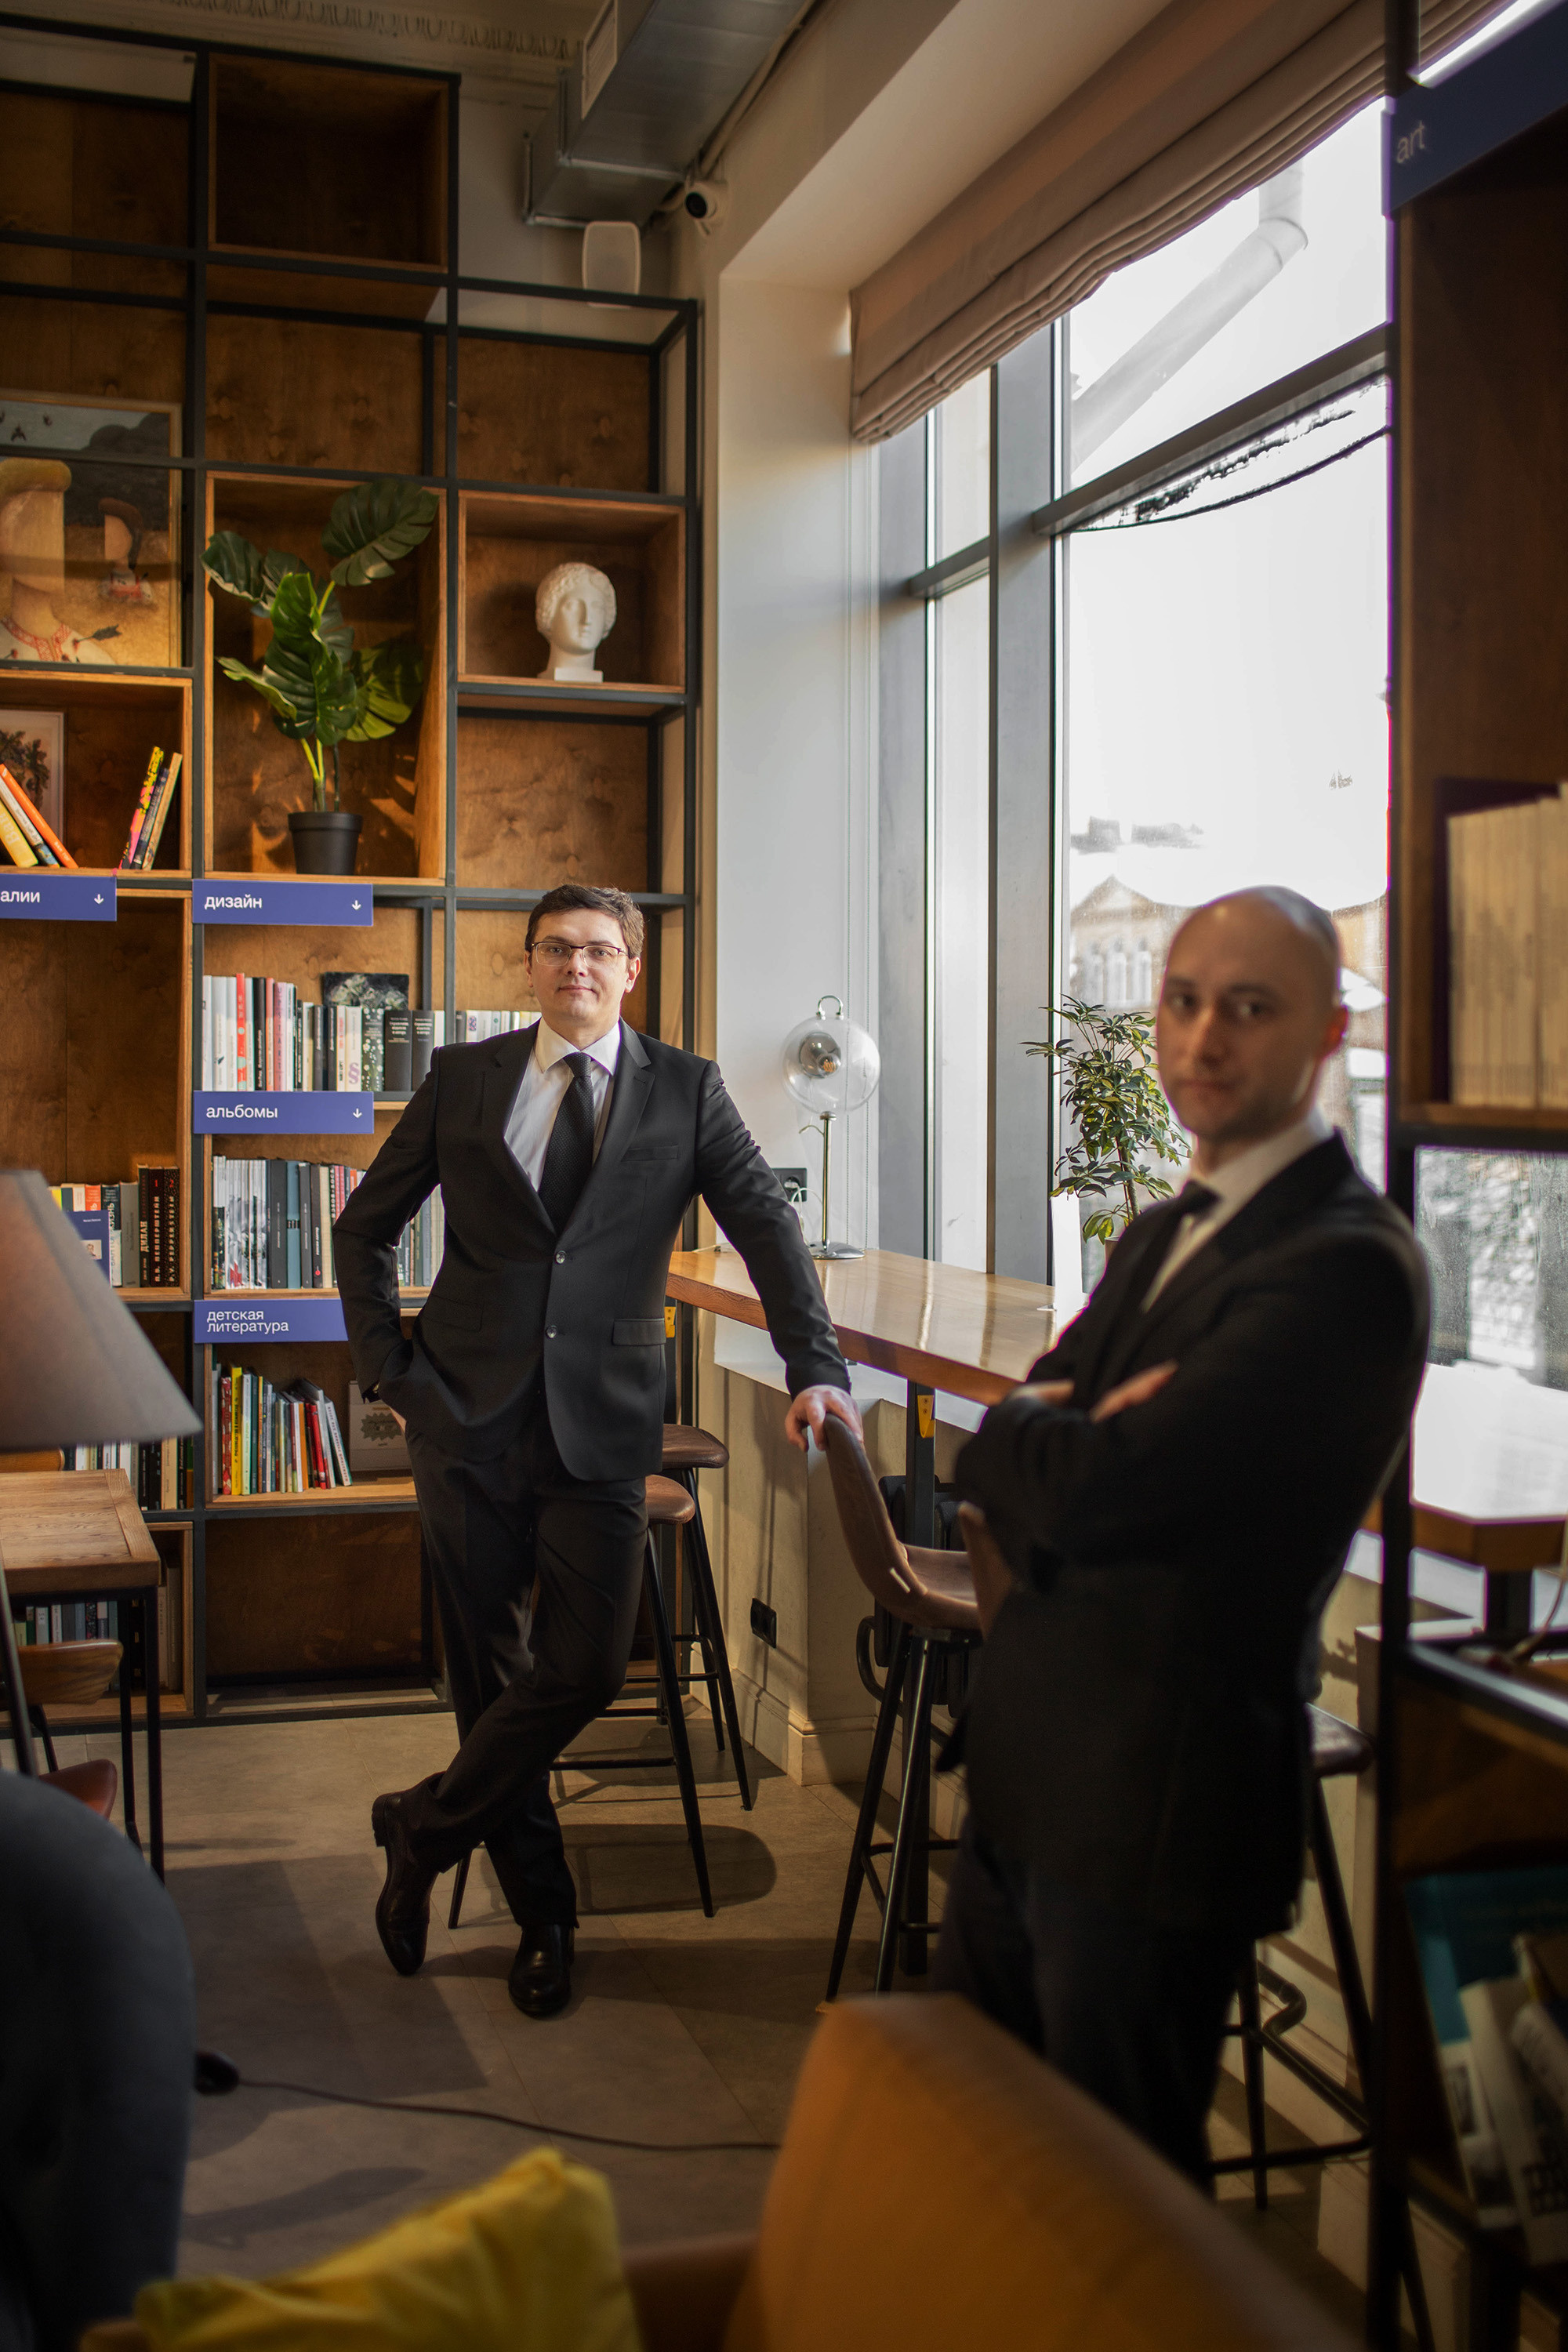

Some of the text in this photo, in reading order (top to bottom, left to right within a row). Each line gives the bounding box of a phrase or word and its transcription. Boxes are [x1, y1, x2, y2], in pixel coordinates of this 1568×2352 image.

[1397, 120, 1425, 164] art
[0, 891, 41, 903] алии
[204, 894, 263, 909] дизайн
[205, 1103, 278, 1118] альбомы
[140, 1221, 150, 1253] ДИЛАН
[206, 1310, 264, 1323] детская
[206, 1322, 289, 1335] литература
